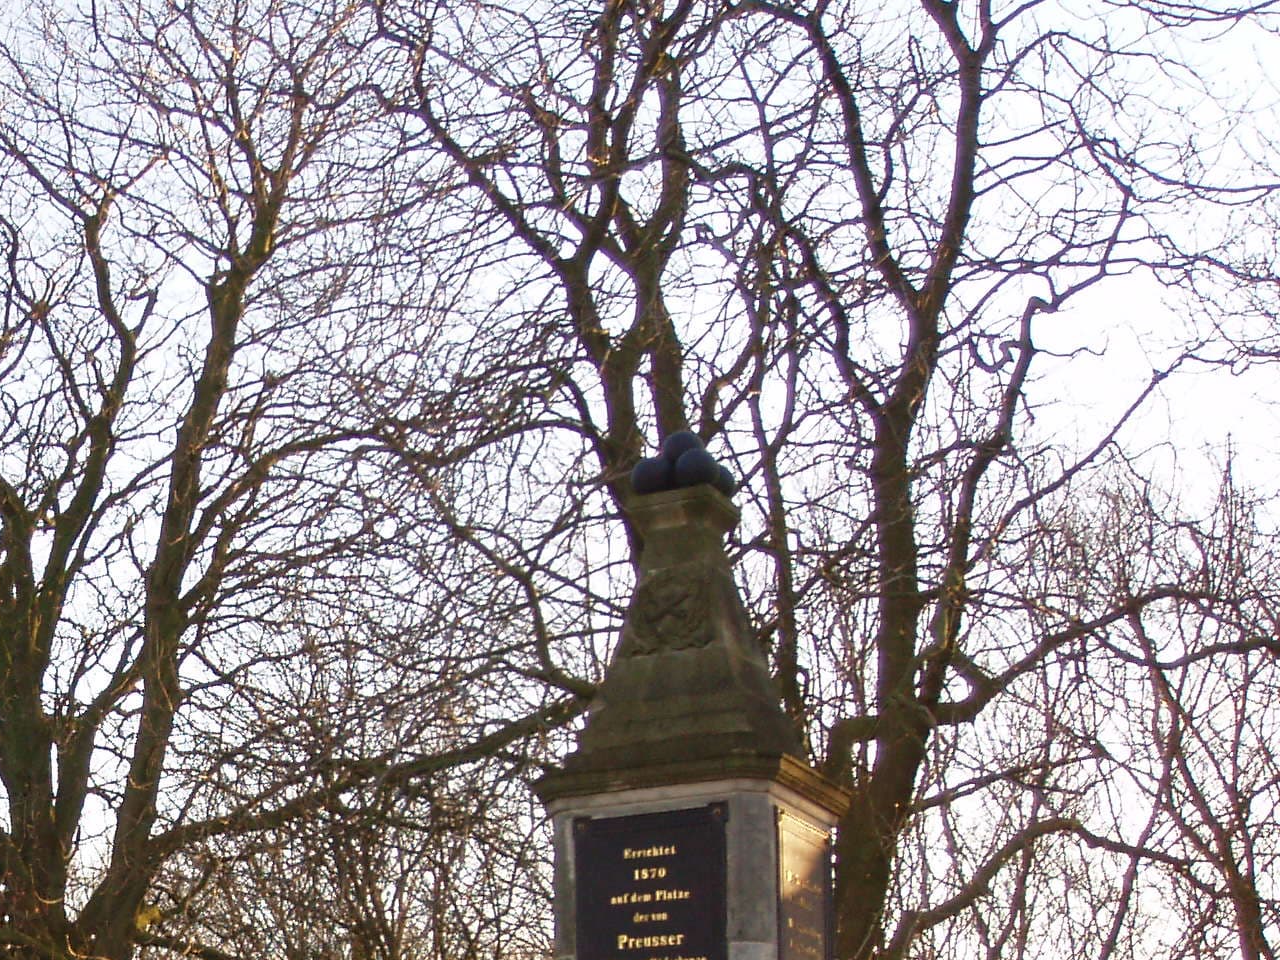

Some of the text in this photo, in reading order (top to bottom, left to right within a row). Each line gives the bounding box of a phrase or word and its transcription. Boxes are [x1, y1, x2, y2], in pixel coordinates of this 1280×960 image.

[623, 845, 676, 860] Errichtet
[634, 867, 667, 880] 1870
[610, 892, 629, 905] auf
[630, 892, 652, 903] dem
[617, 934, 685, 950] Preusser
